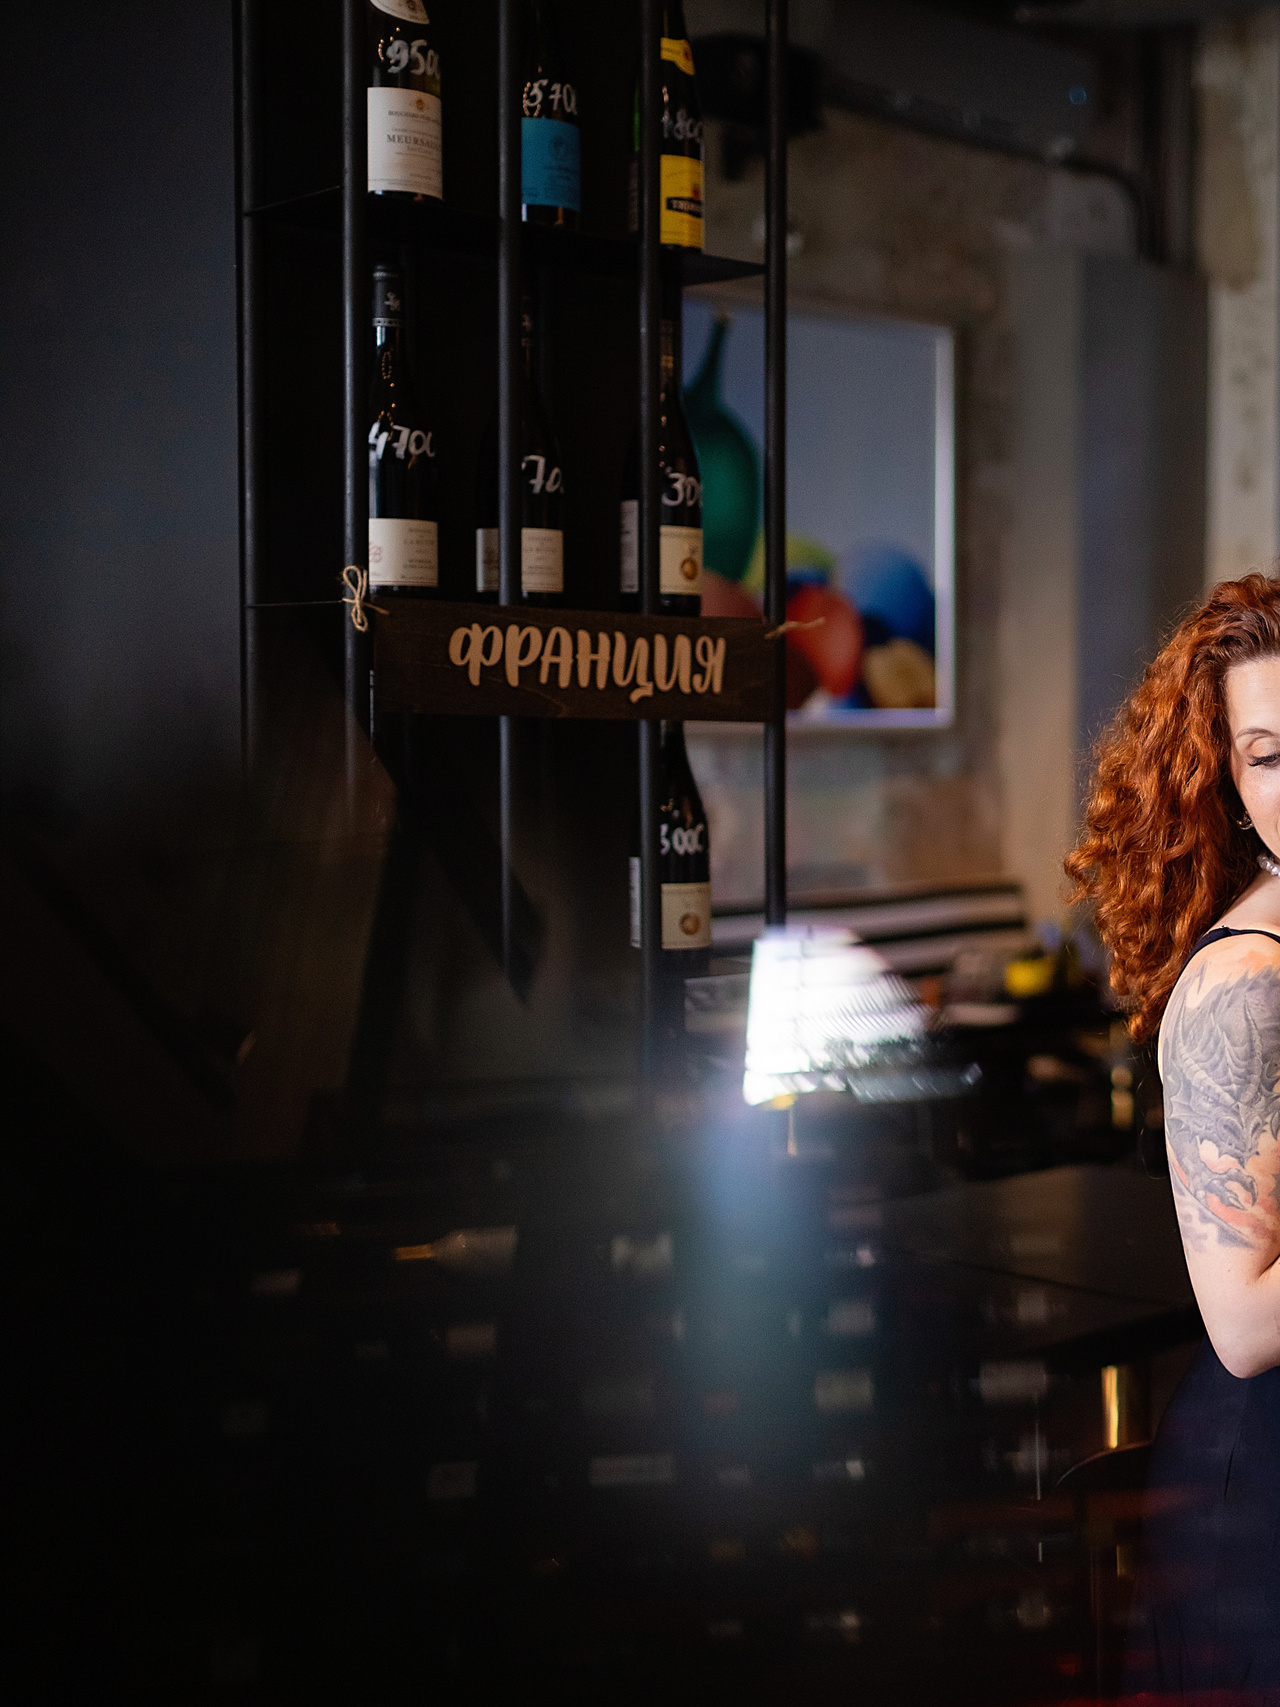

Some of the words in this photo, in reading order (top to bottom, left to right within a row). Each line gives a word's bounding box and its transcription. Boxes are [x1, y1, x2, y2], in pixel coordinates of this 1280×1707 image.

[386, 39, 440, 79] 950
[525, 78, 578, 115] 570
[521, 454, 565, 495] 70
[661, 471, 703, 508] 30
[449, 623, 726, 703] ФРАНЦИЯ
